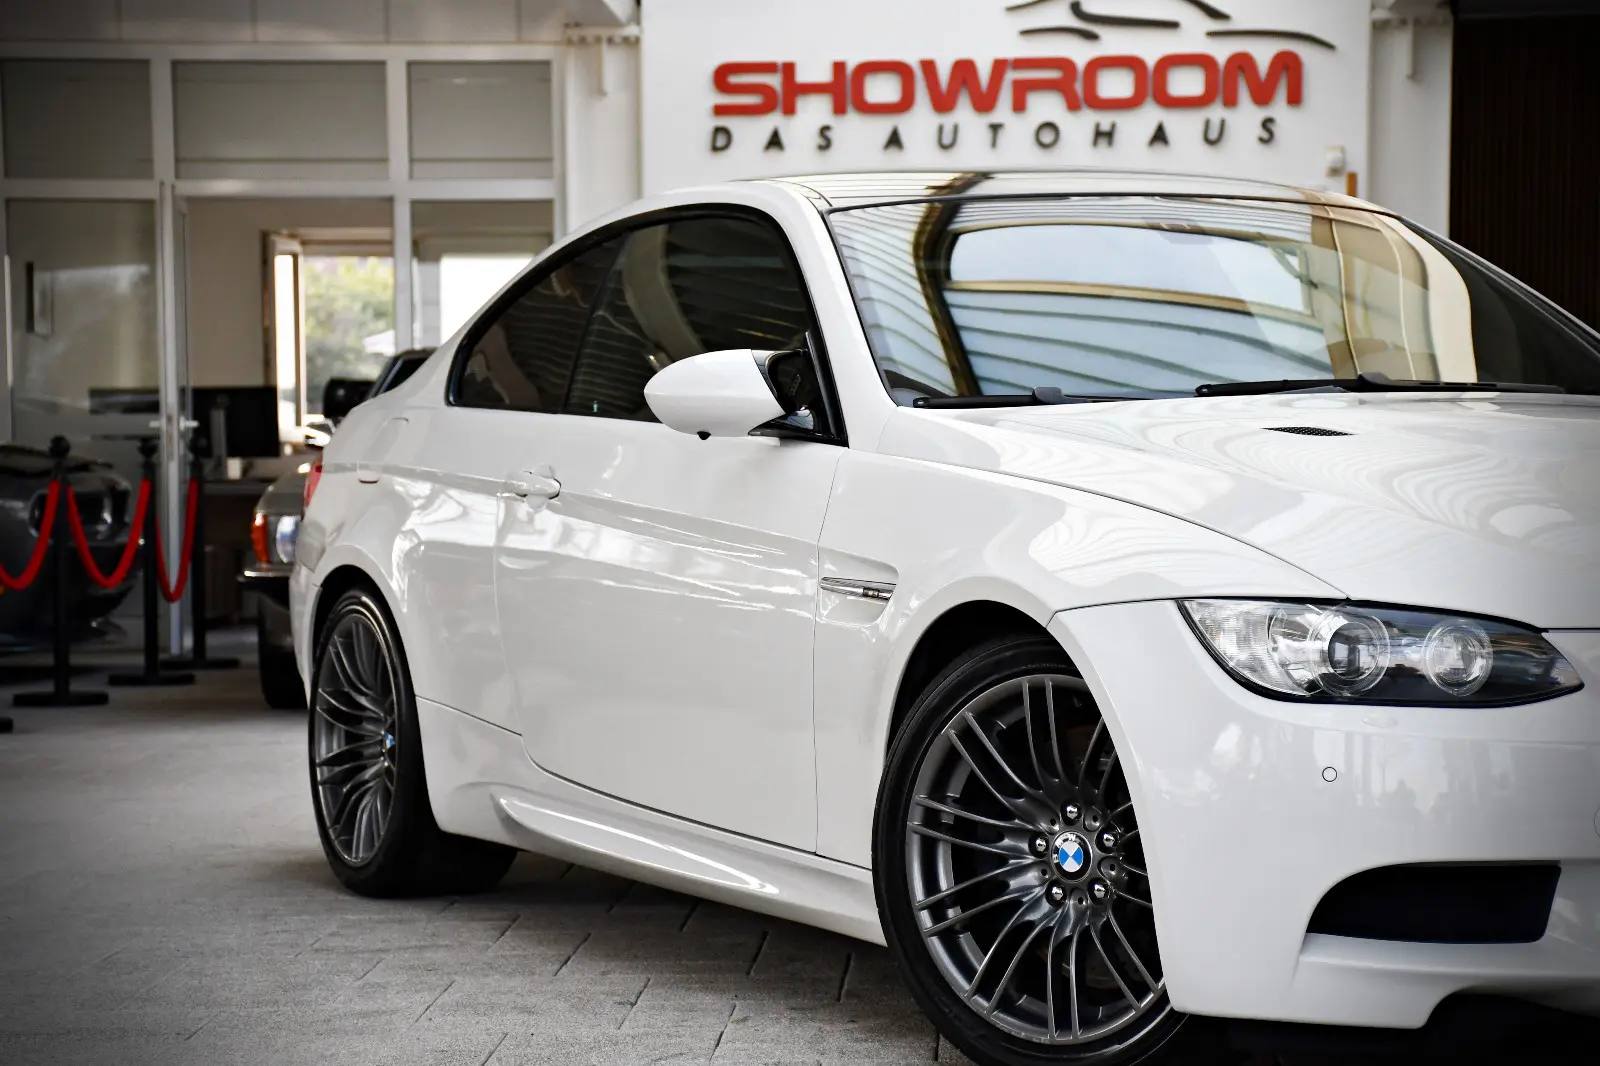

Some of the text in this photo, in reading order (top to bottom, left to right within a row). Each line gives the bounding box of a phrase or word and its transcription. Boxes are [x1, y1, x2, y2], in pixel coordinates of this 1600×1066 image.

[712, 50, 1304, 117] SHOWROOM
[711, 117, 1277, 153] DAS AUTOHAUS
